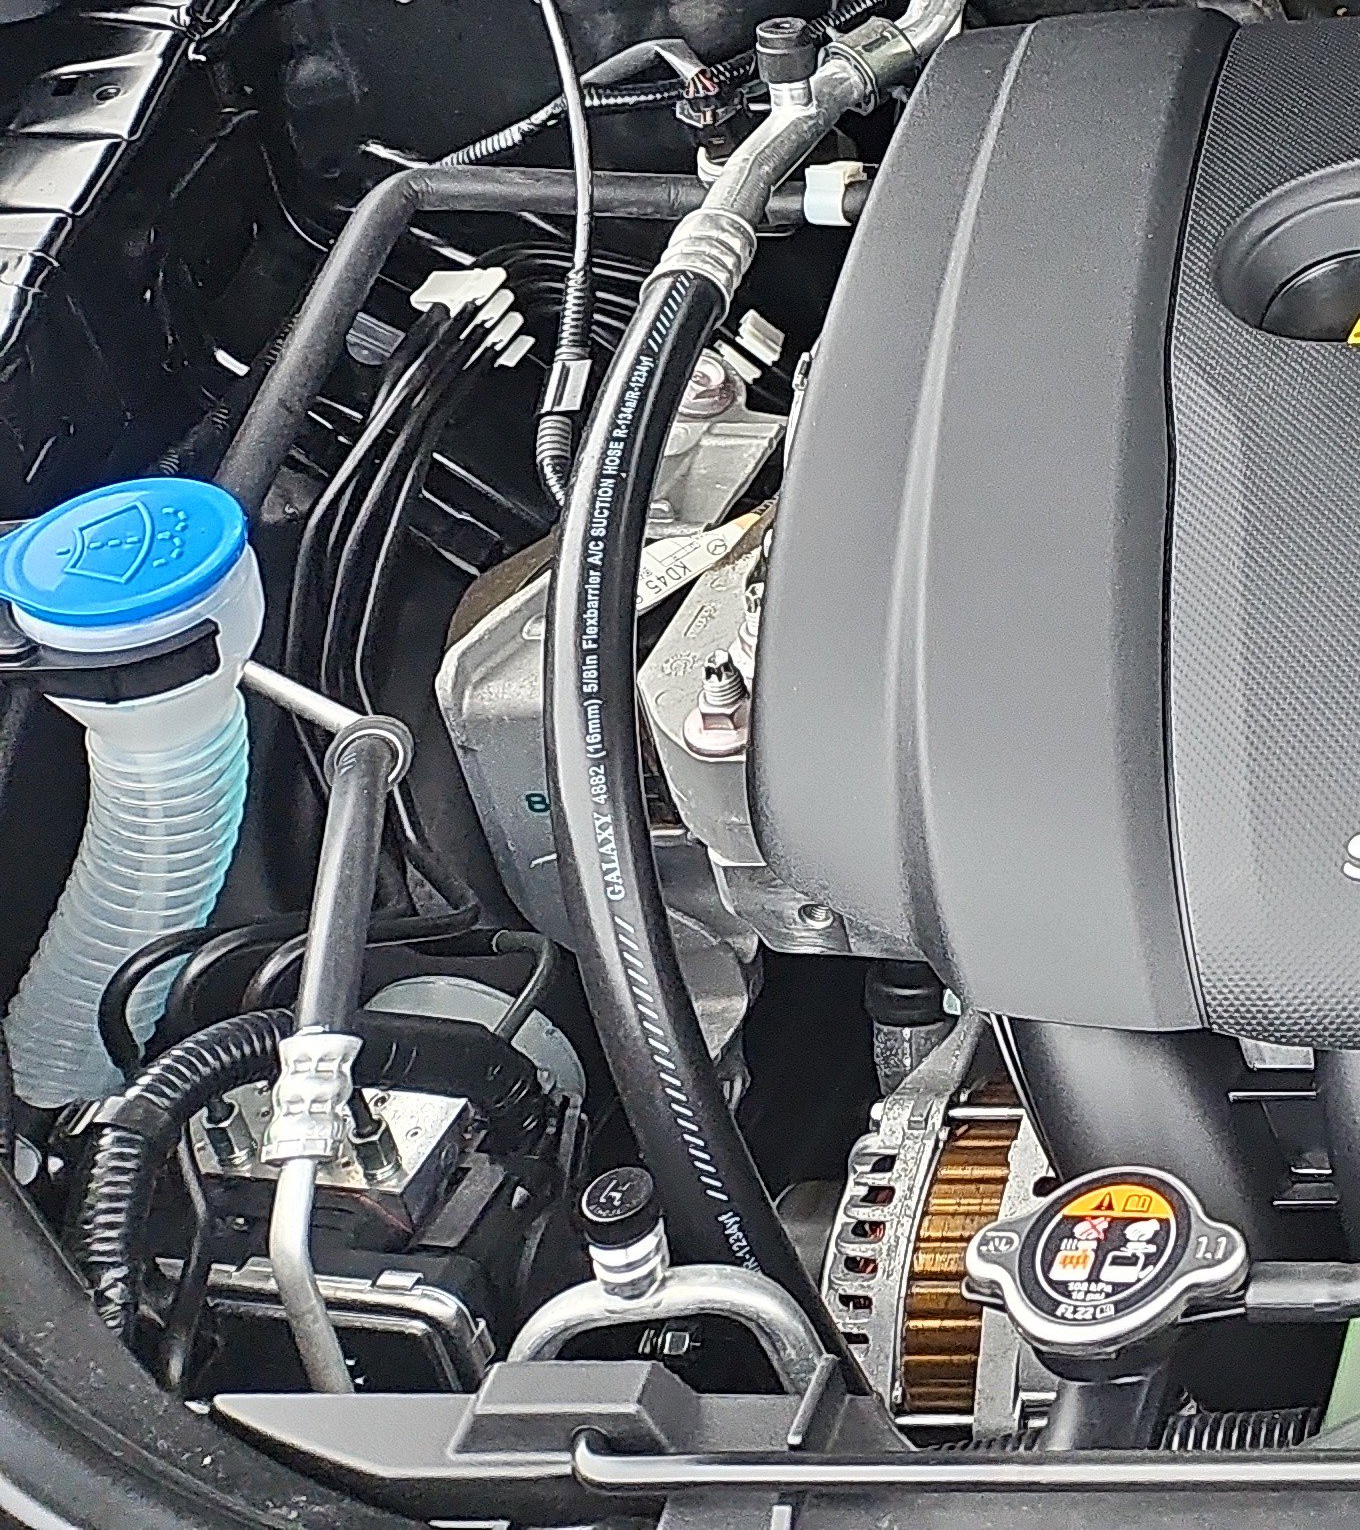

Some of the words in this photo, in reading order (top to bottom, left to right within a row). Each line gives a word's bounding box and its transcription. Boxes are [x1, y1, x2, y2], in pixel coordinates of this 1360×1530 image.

[602, 440, 625, 475] HOSE
[590, 478, 616, 537] SUCTION
[587, 541, 605, 567] A/C
[582, 569, 602, 650] Flexbarrier
[583, 699, 606, 759] (16mm)
[589, 764, 608, 804] 4882
[593, 812, 626, 901] GALAXY
[1195, 1236, 1227, 1259] 1.1
[1054, 1303, 1095, 1320] FL22
